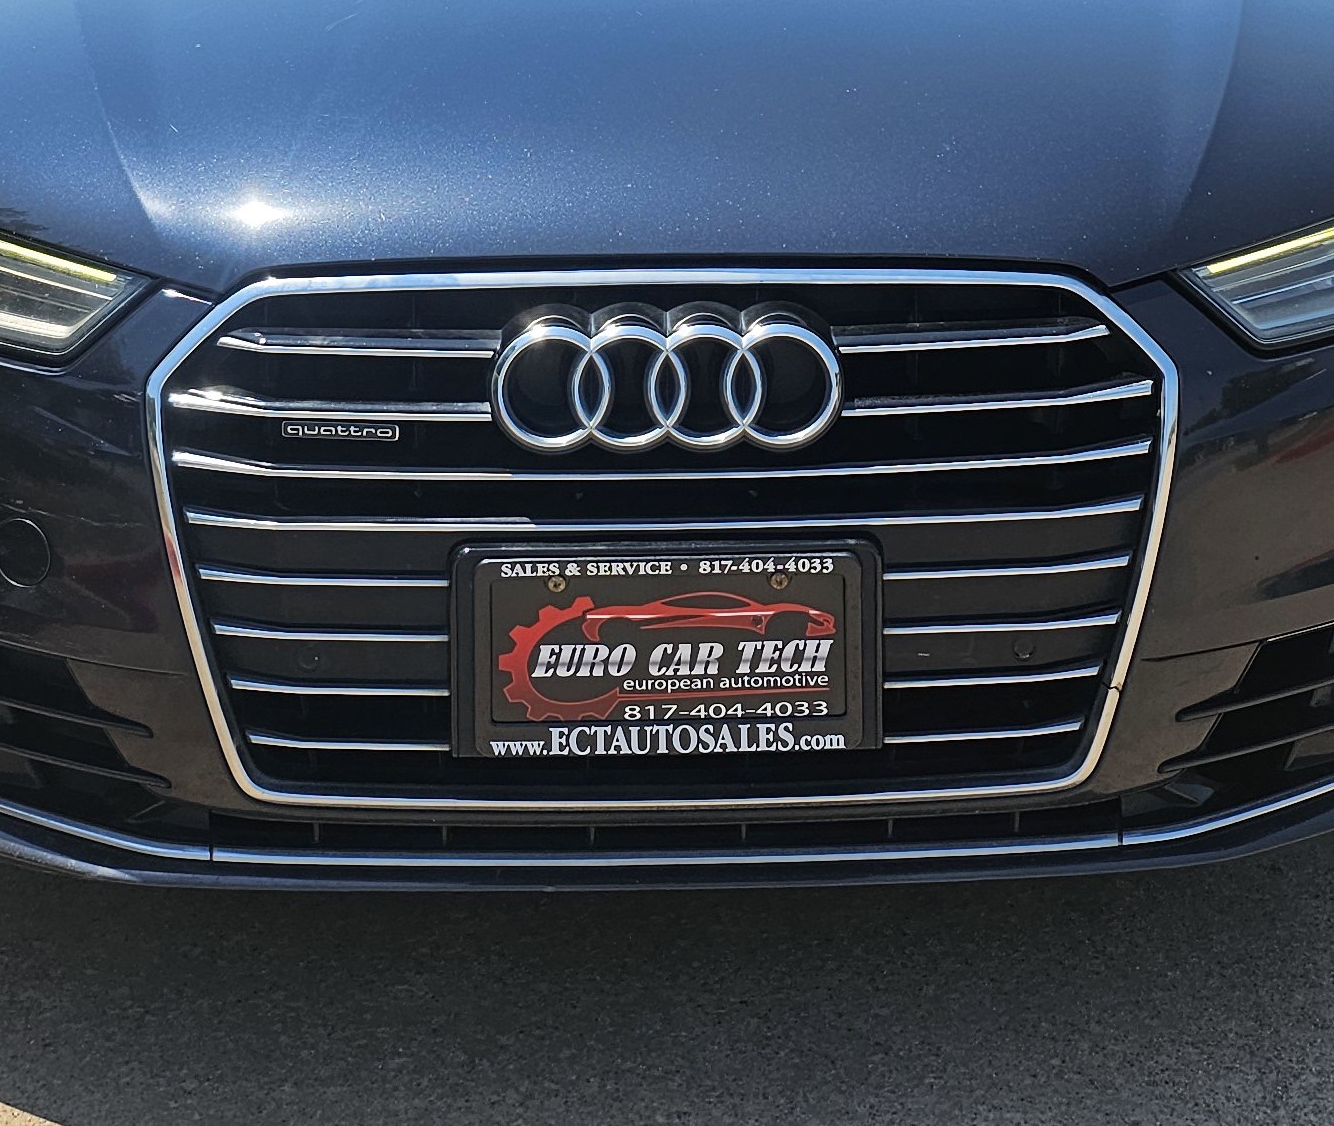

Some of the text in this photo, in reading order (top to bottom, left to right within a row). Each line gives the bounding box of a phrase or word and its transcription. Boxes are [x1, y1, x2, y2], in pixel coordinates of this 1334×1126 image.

[286, 425, 393, 437] quattro
[500, 558, 834, 578] SALES & SERVICE 817-404-4033
[531, 639, 834, 678] EURO CAR TECH
[623, 673, 829, 692] european automotive
[623, 701, 829, 721] 817-404-4033
[490, 723, 846, 757] www.ECTAUTOSALES.com
